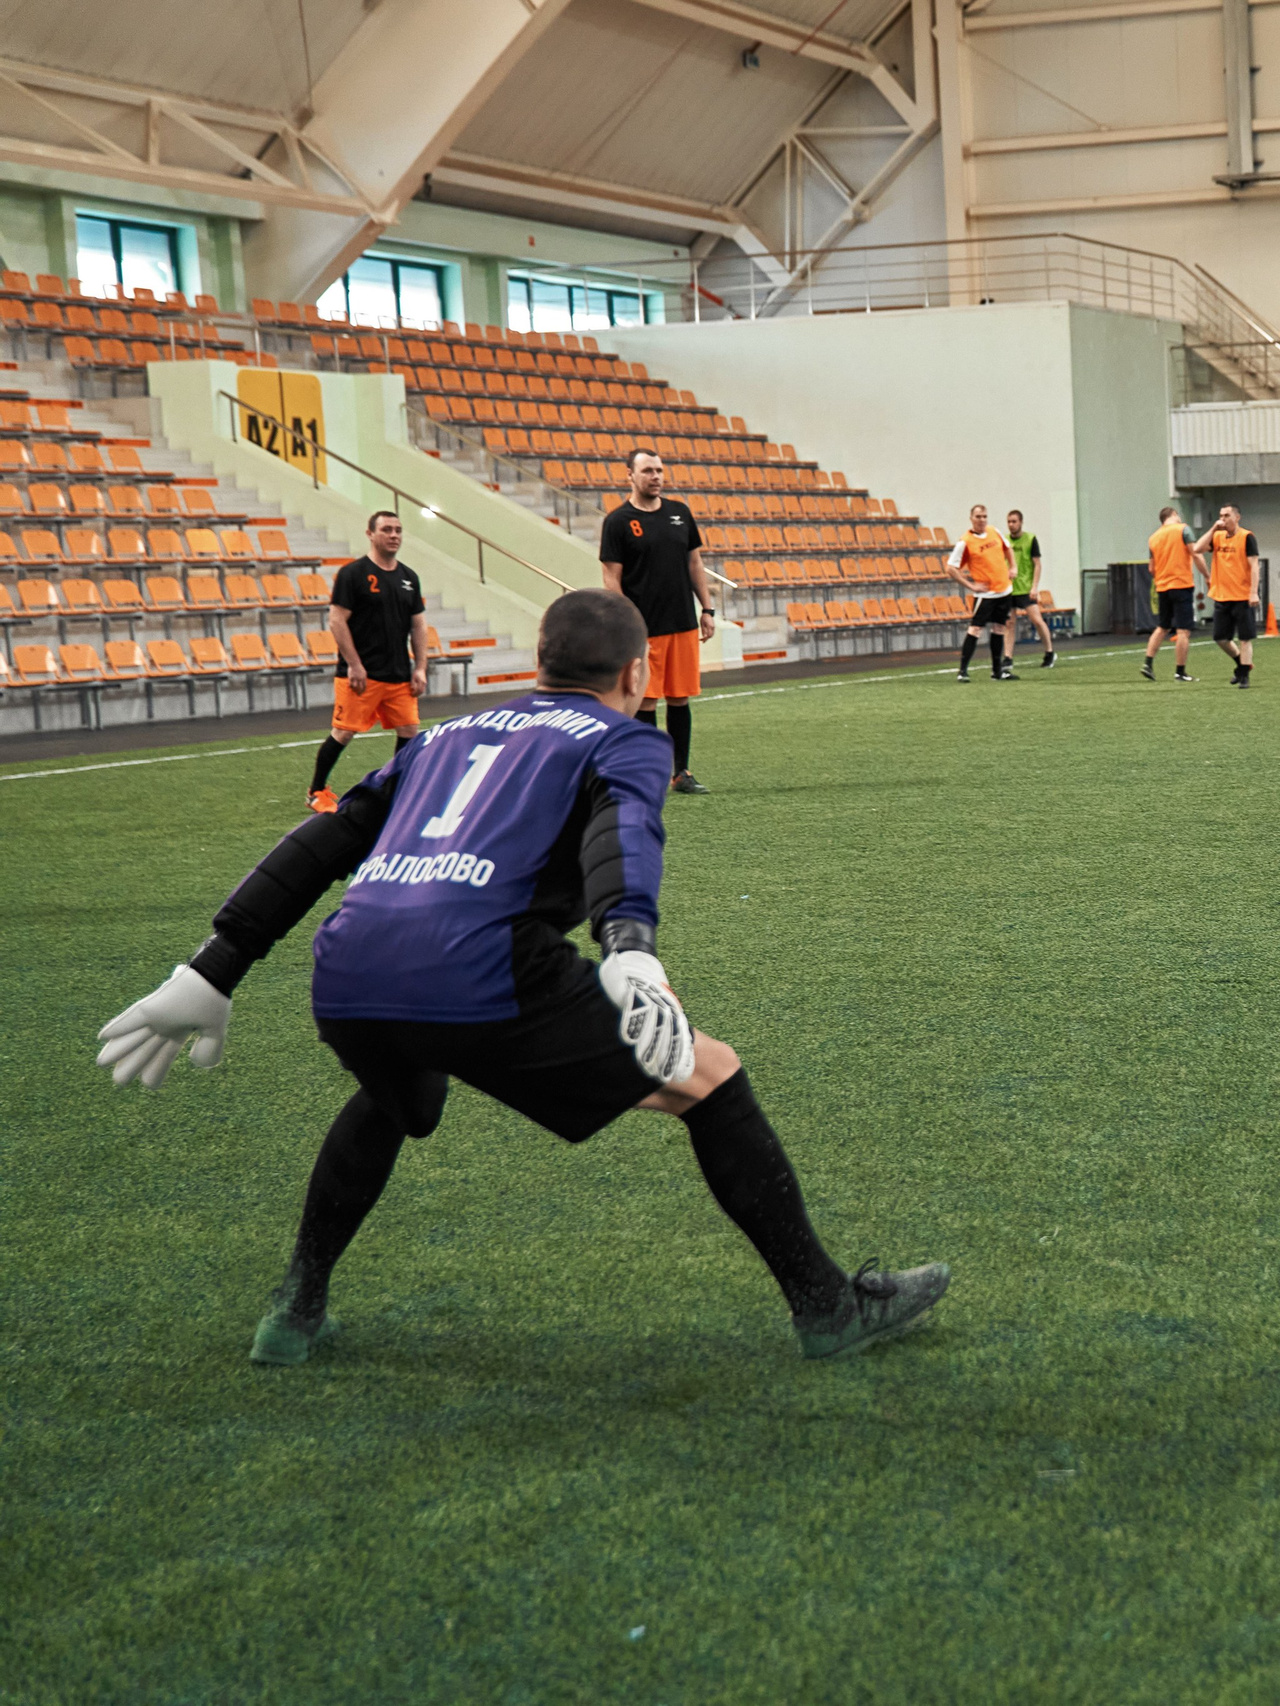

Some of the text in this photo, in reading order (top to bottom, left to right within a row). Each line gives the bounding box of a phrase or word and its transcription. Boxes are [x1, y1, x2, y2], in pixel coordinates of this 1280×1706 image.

[629, 519, 644, 537] 8
[367, 574, 380, 593] 2
[421, 744, 506, 838] 1
